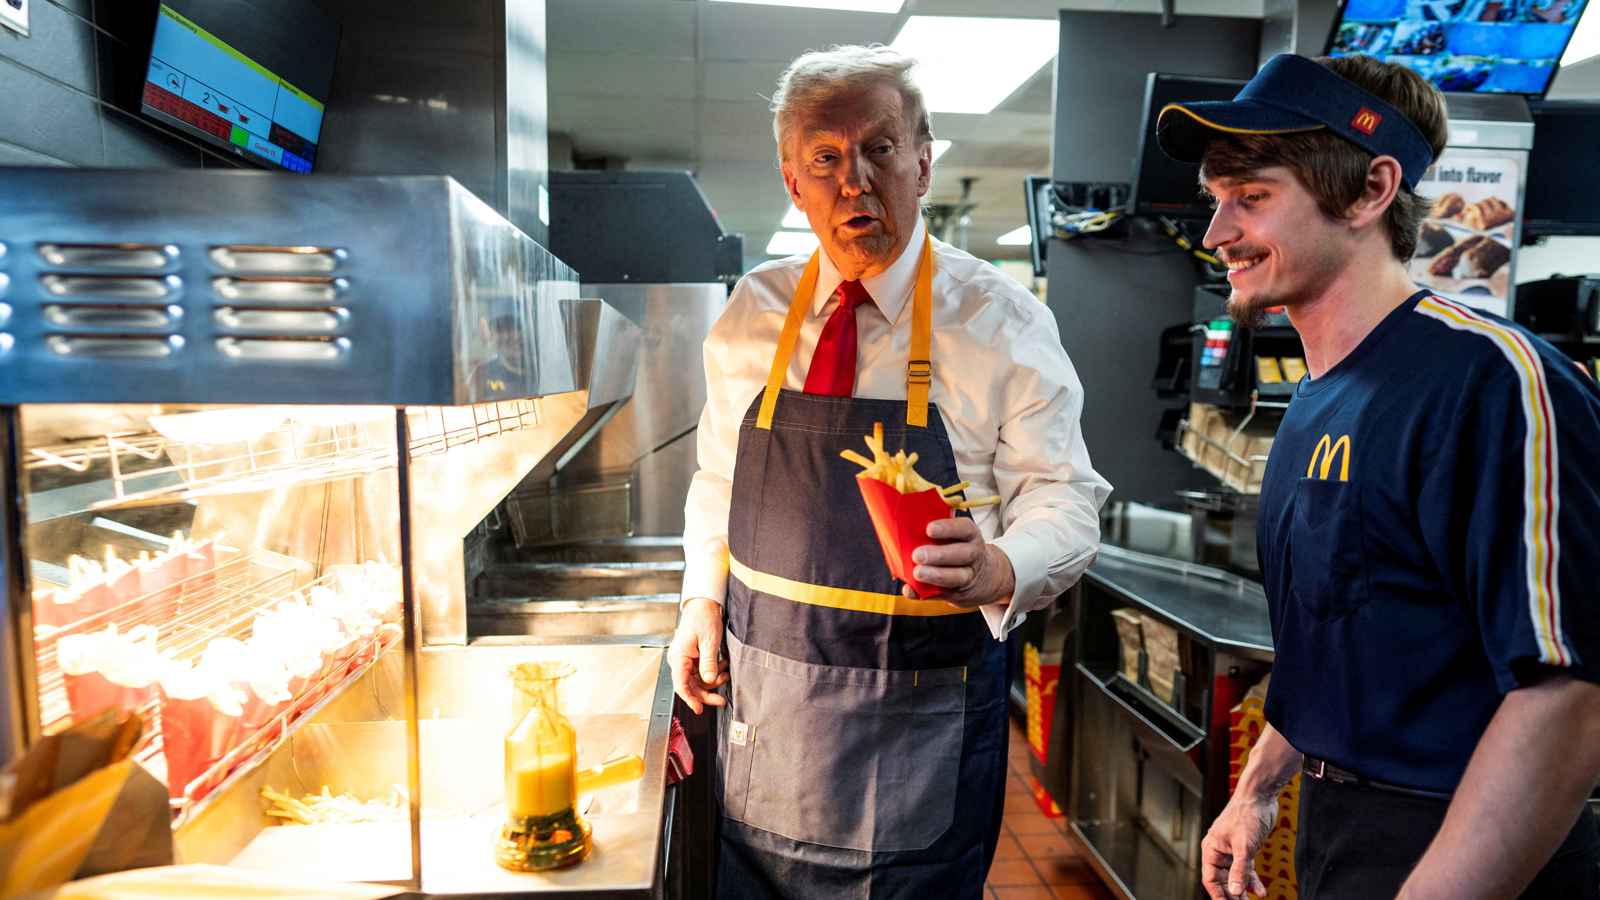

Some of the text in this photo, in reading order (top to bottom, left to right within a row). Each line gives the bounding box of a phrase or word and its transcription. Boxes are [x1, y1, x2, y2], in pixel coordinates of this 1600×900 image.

[202, 91, 210, 105] 2
[1439, 165, 1463, 182] into
[1466, 166, 1503, 184] flavor
